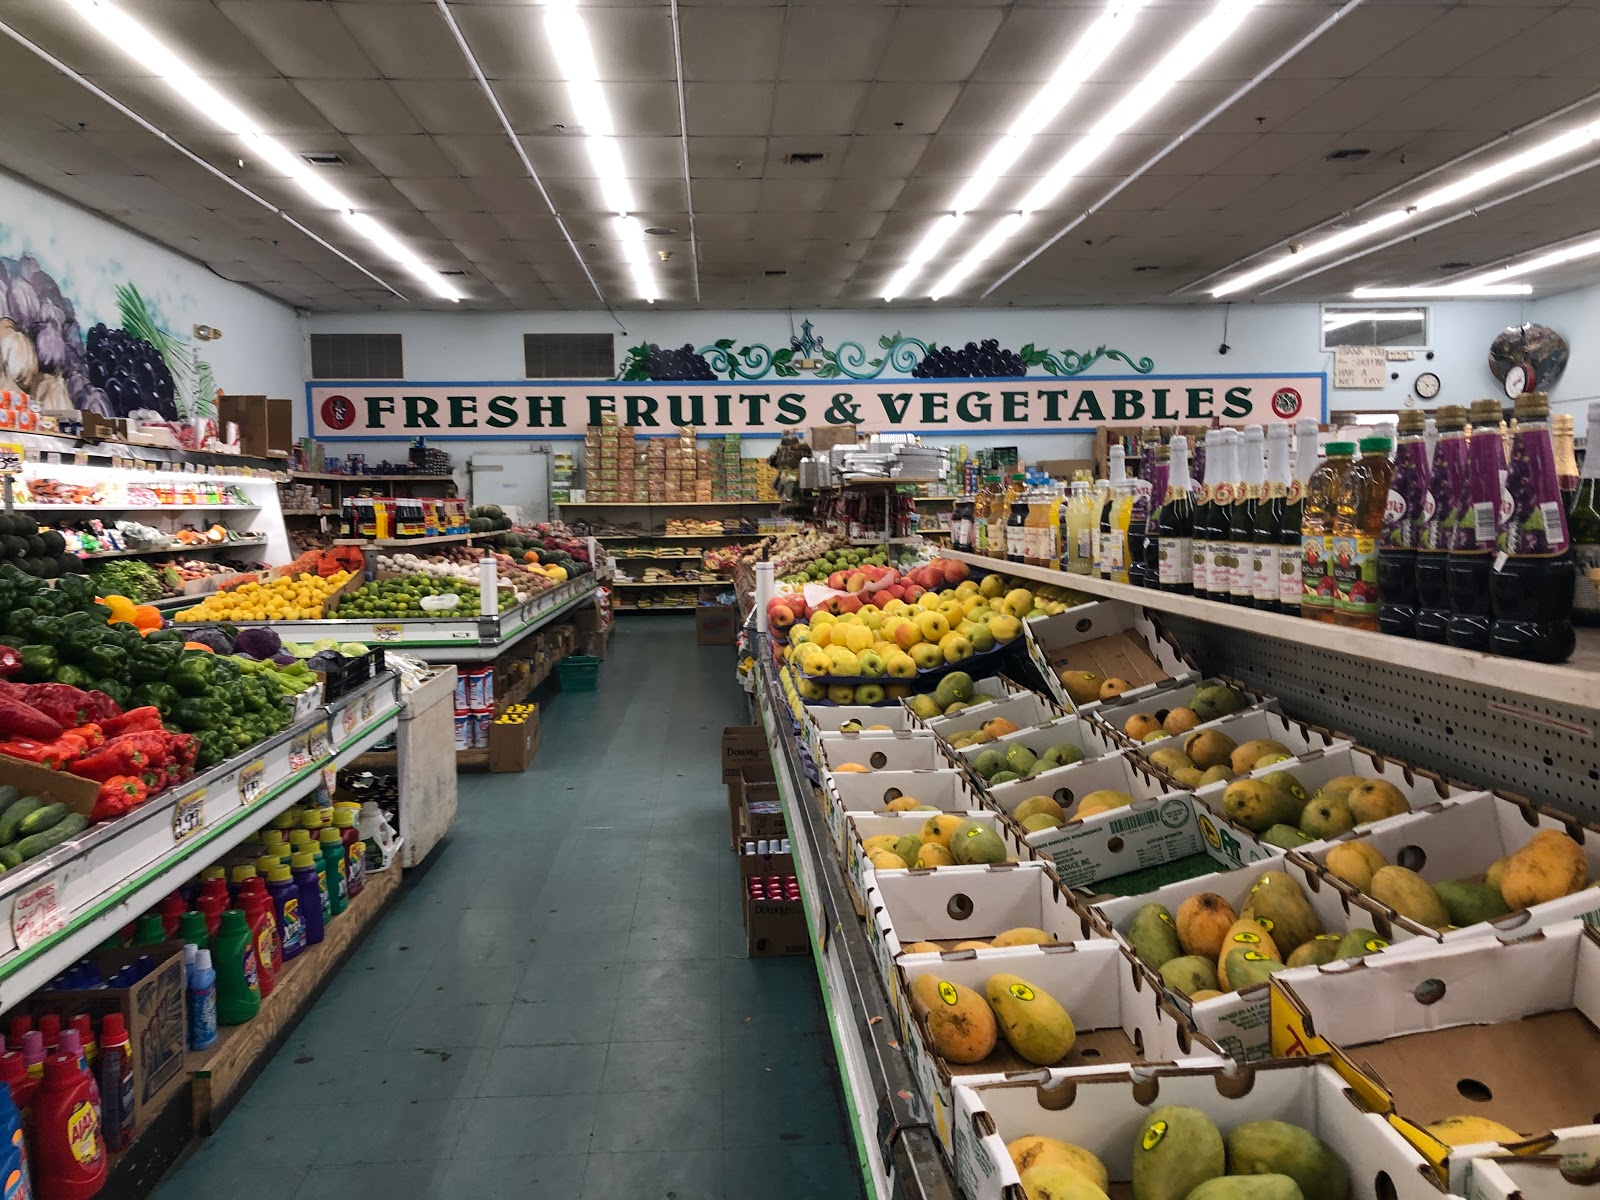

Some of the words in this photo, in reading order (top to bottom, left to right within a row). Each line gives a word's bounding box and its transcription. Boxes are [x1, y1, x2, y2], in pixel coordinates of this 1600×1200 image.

[365, 395, 566, 429] FRESH
[586, 393, 807, 428] FRUITS
[824, 393, 865, 425] &
[878, 386, 1253, 425] VEGETABLES
[727, 747, 759, 757] Downy
[72, 1111, 94, 1147] AJAX
